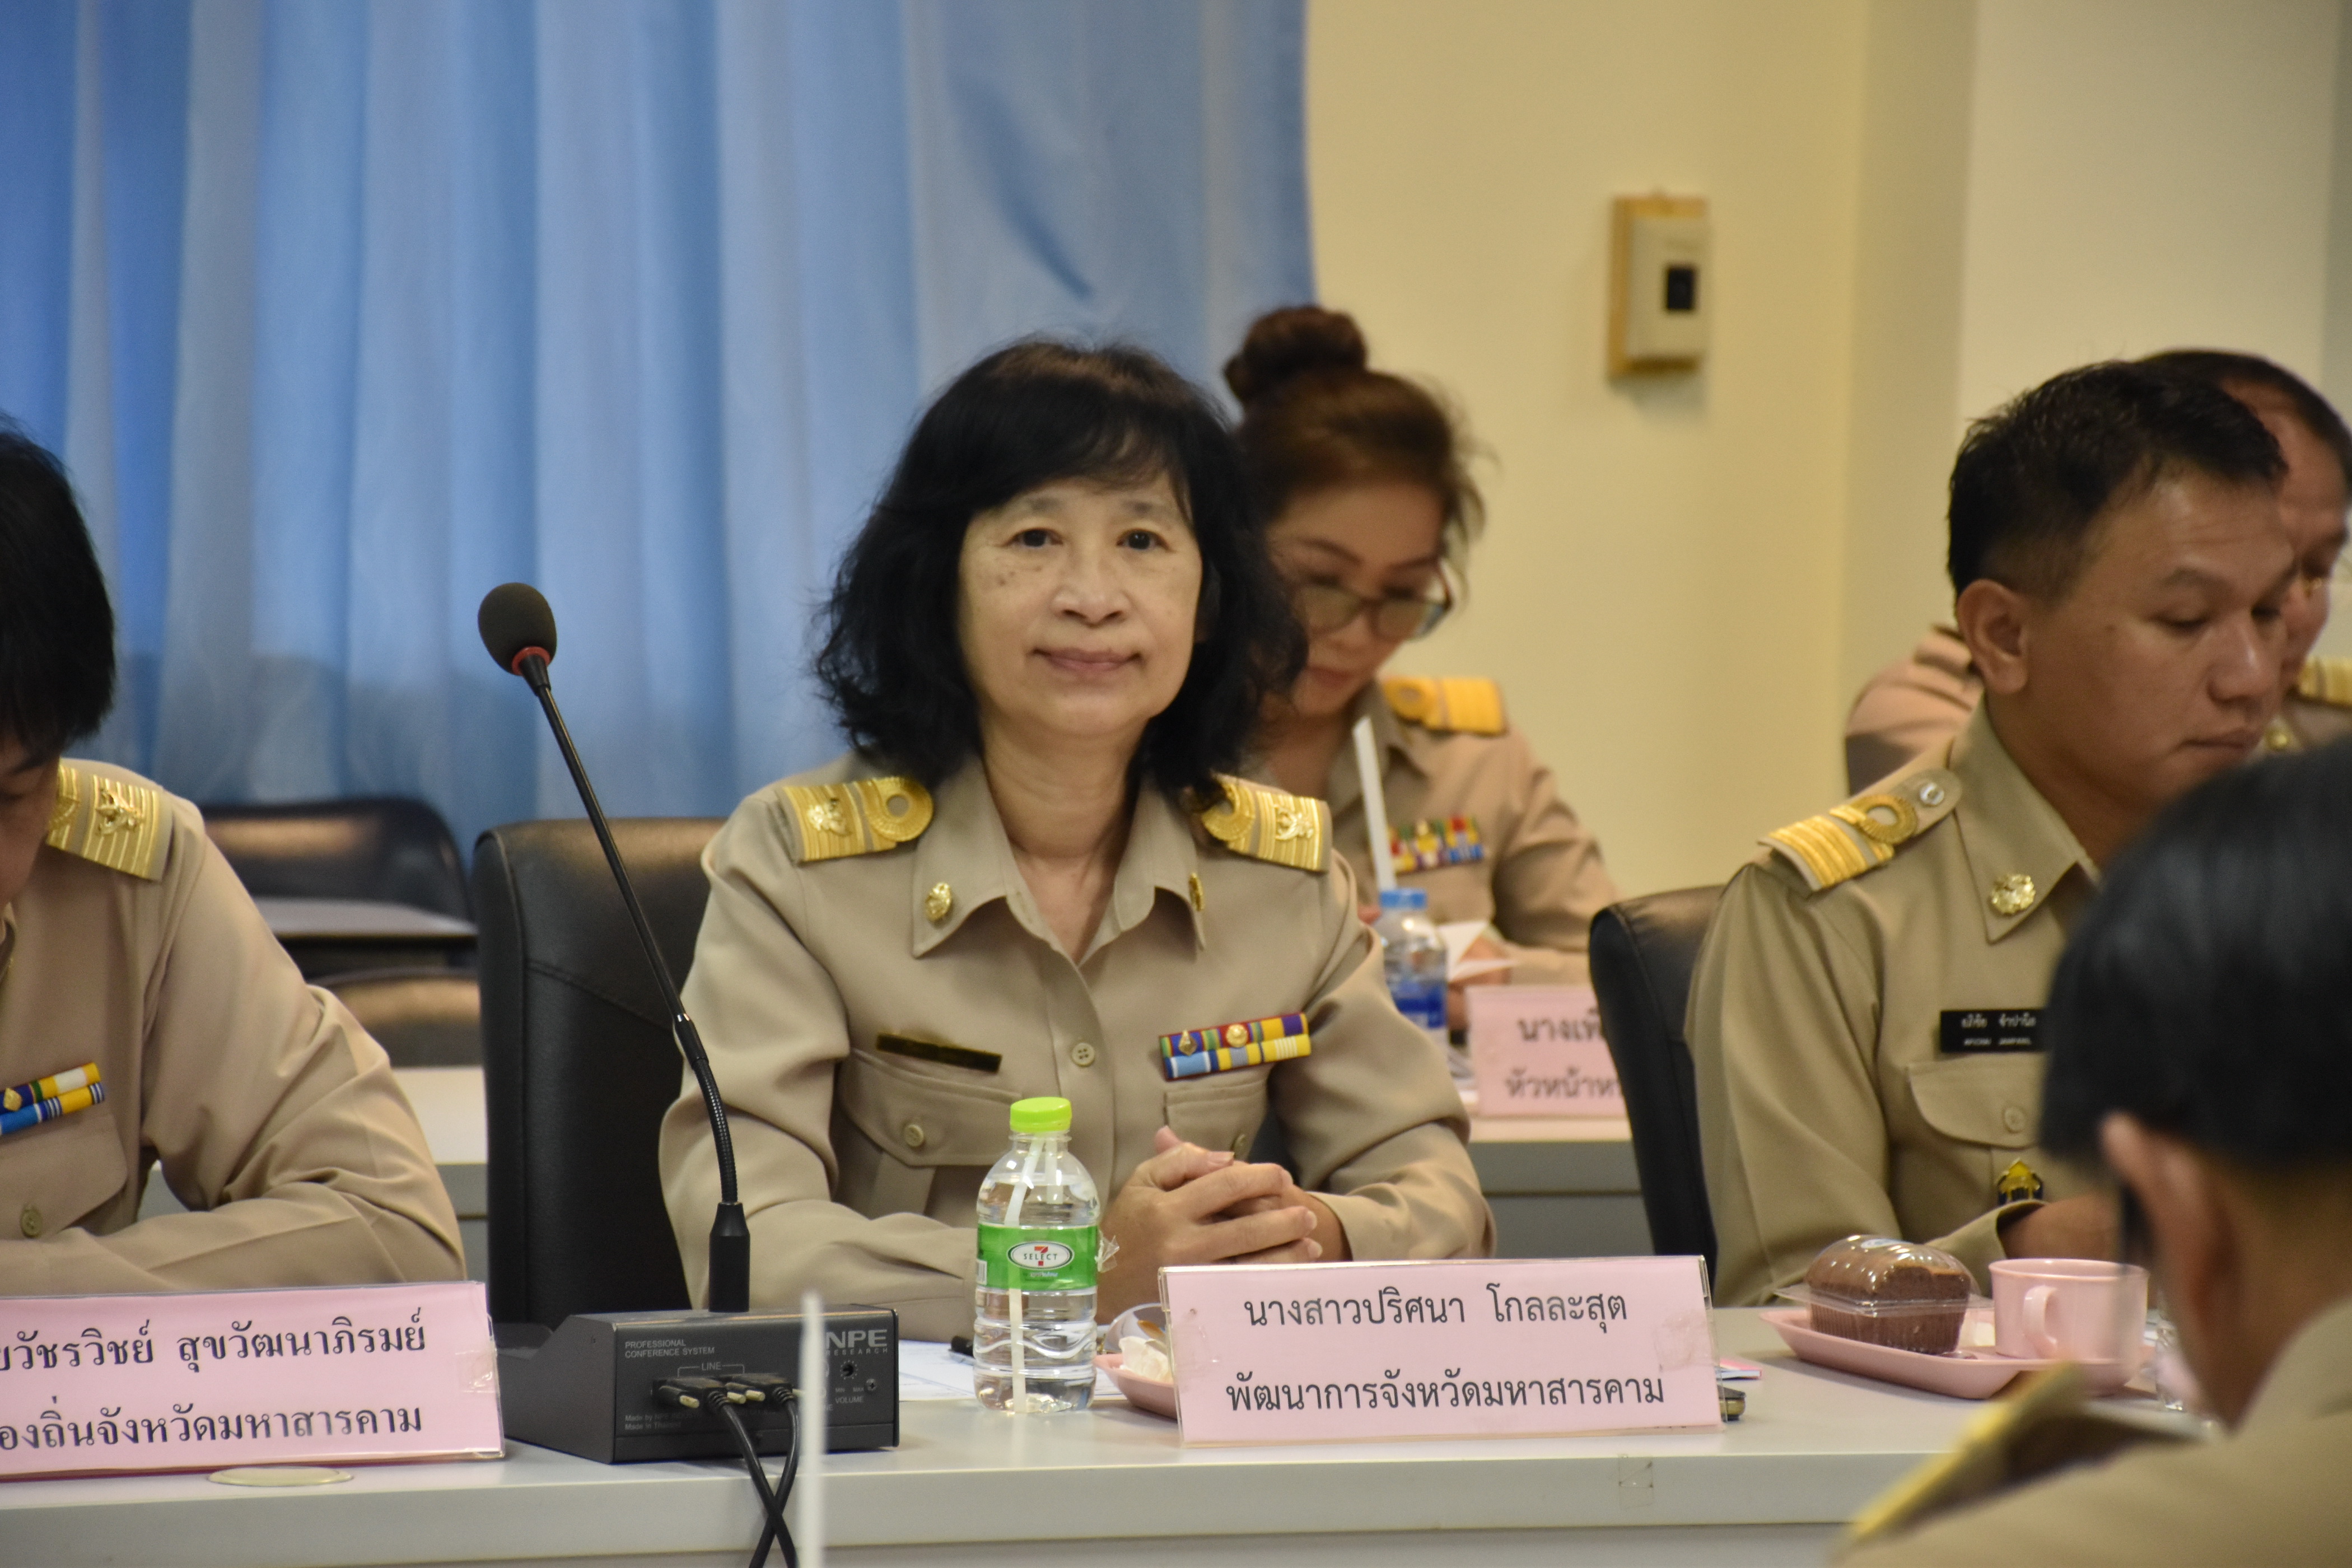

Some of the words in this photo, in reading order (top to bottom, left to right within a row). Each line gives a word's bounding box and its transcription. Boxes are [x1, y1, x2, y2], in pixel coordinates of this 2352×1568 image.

[1243, 1286, 1465, 1326] นางสาวปริศนา
[1486, 1282, 1627, 1334] โกลละสุต
[176, 1307, 426, 1373] สุขวัฒนาภิรมย์
[625, 1339, 686, 1348] PROFESSIONAL
[825, 1329, 888, 1348] NPE
[625, 1348, 679, 1358] CONFERENCE
[683, 1347, 715, 1355] SYSTEM
[701, 1362, 722, 1371] LINE
[1225, 1367, 1664, 1411] พัฒนาการจังหวัดมหาสารคาม
